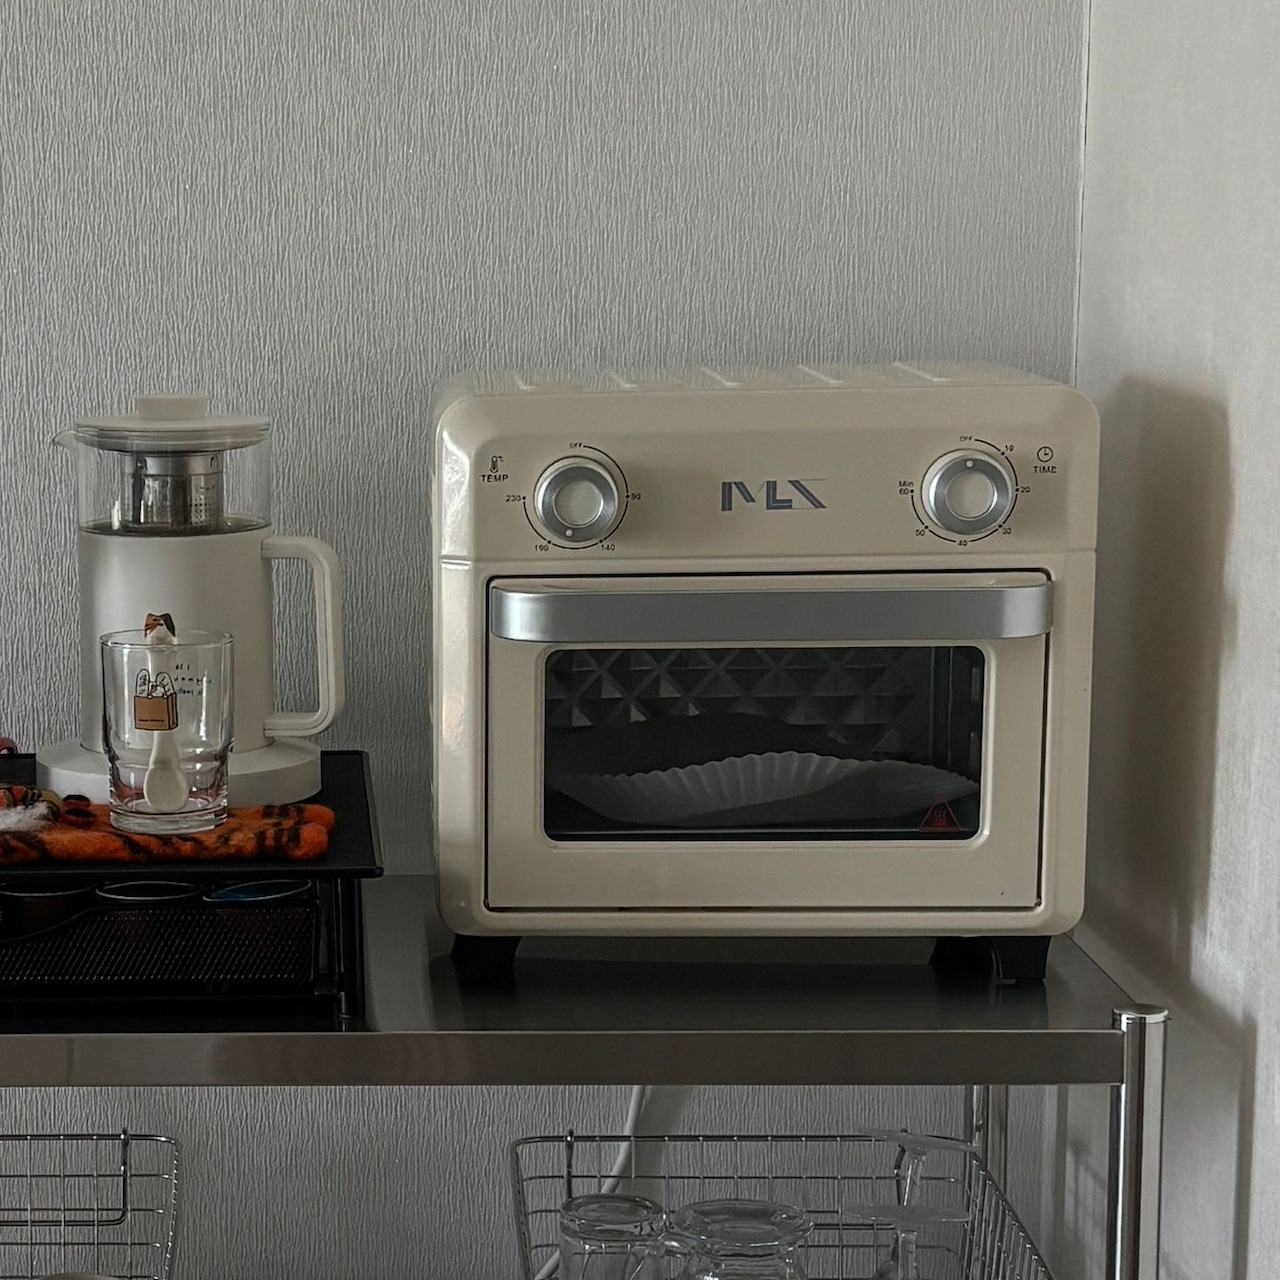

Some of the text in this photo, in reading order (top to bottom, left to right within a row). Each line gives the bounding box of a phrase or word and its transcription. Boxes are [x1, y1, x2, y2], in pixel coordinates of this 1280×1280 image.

[1033, 466, 1058, 474] TIME
[481, 474, 509, 483] TEMP
[534, 544, 549, 552] 190
